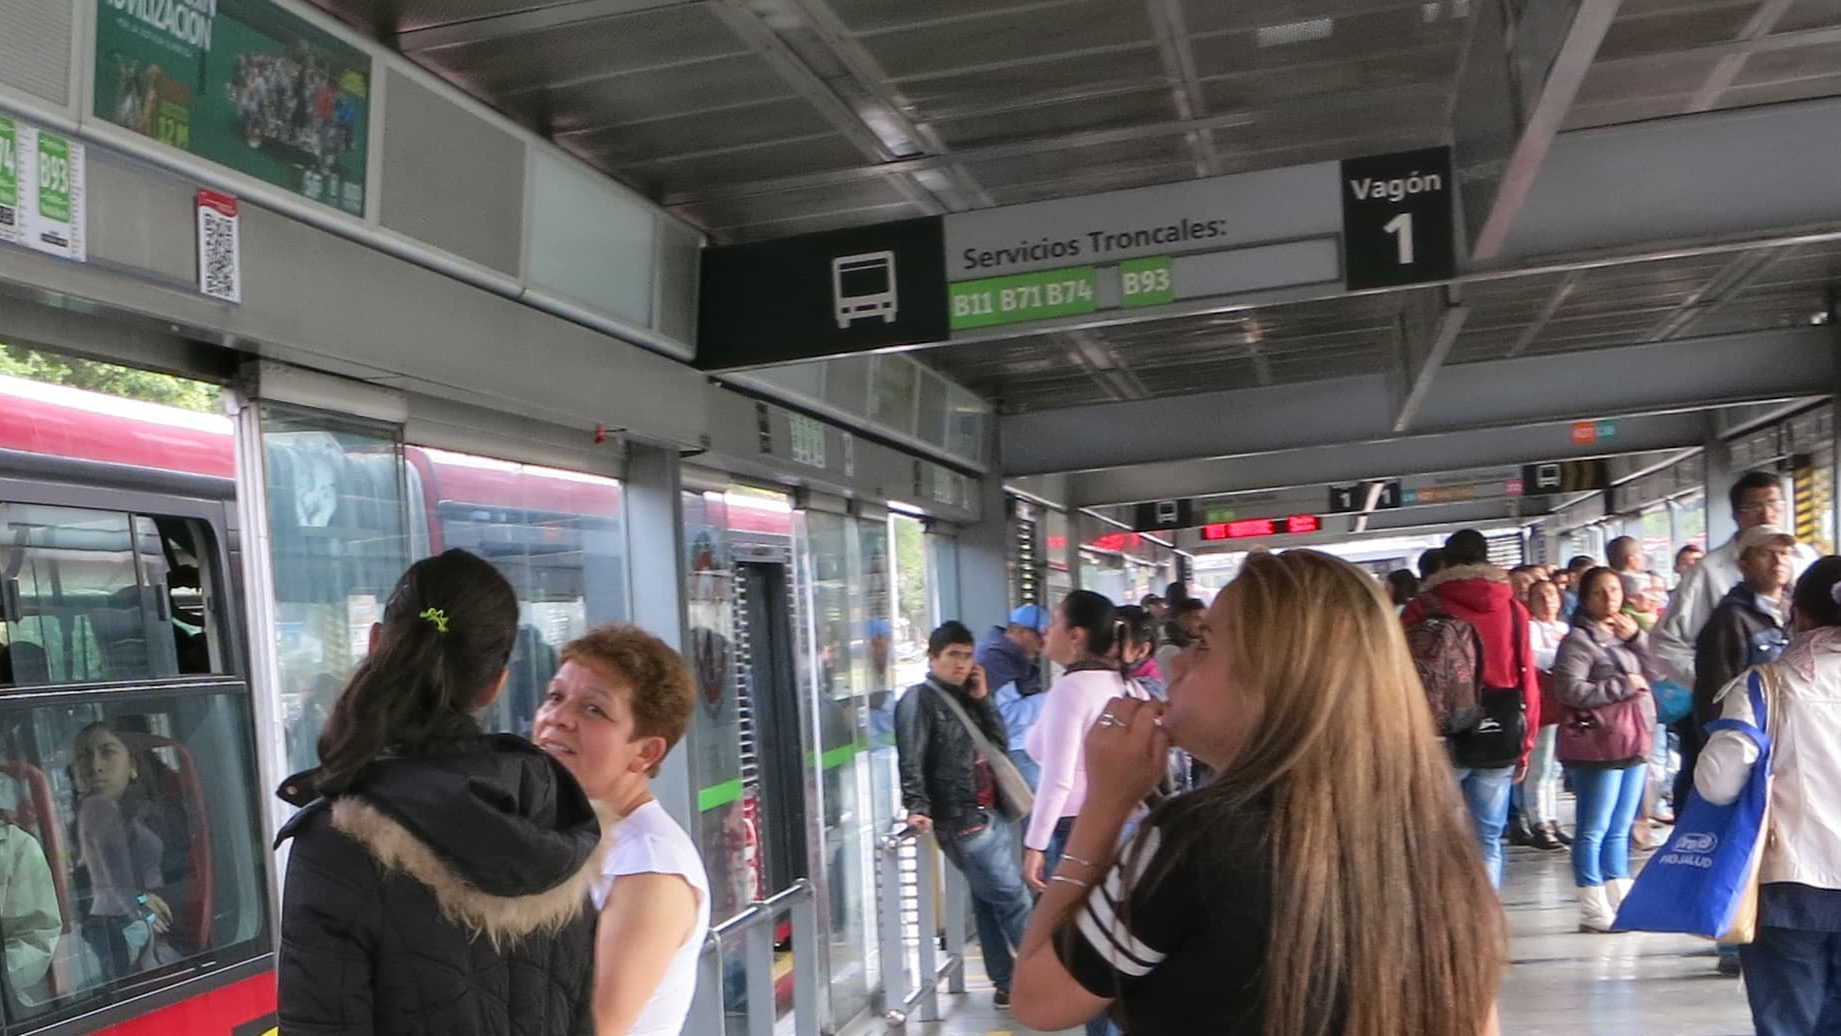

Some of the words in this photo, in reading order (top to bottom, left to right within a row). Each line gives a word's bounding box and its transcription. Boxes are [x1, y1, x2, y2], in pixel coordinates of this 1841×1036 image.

[39, 150, 70, 195] B93
[1349, 169, 1442, 202] Vagón
[962, 238, 1080, 270] Servicios
[1087, 218, 1228, 253] Troncales:
[1382, 212, 1415, 264] 1
[954, 291, 994, 318] B11
[1000, 285, 1042, 312] B71
[1047, 279, 1094, 306] B74
[1122, 269, 1171, 296] B93
